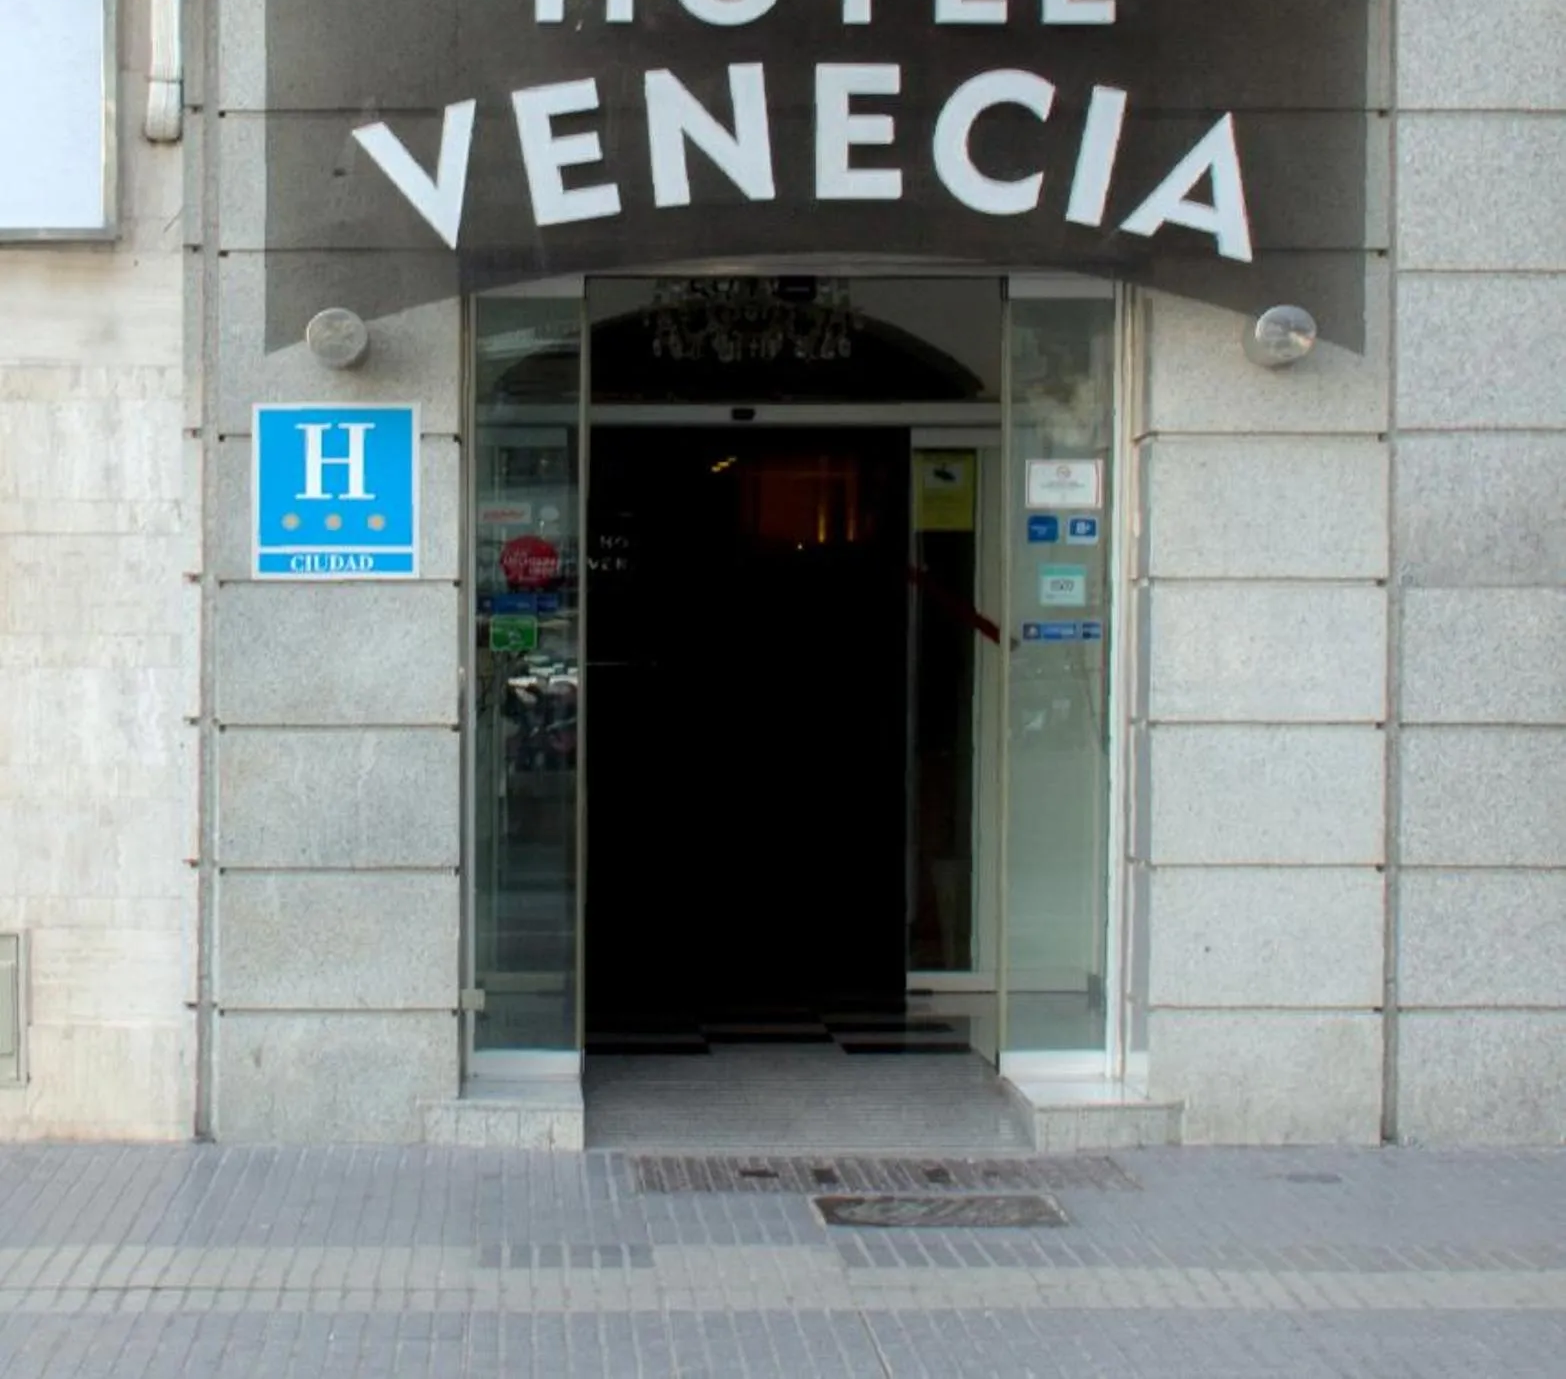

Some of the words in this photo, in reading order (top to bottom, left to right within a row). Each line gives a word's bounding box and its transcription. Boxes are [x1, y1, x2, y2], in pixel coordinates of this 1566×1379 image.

[352, 63, 1253, 262] VENECIA
[295, 422, 376, 500] H
[290, 554, 374, 572] CIUDAD
